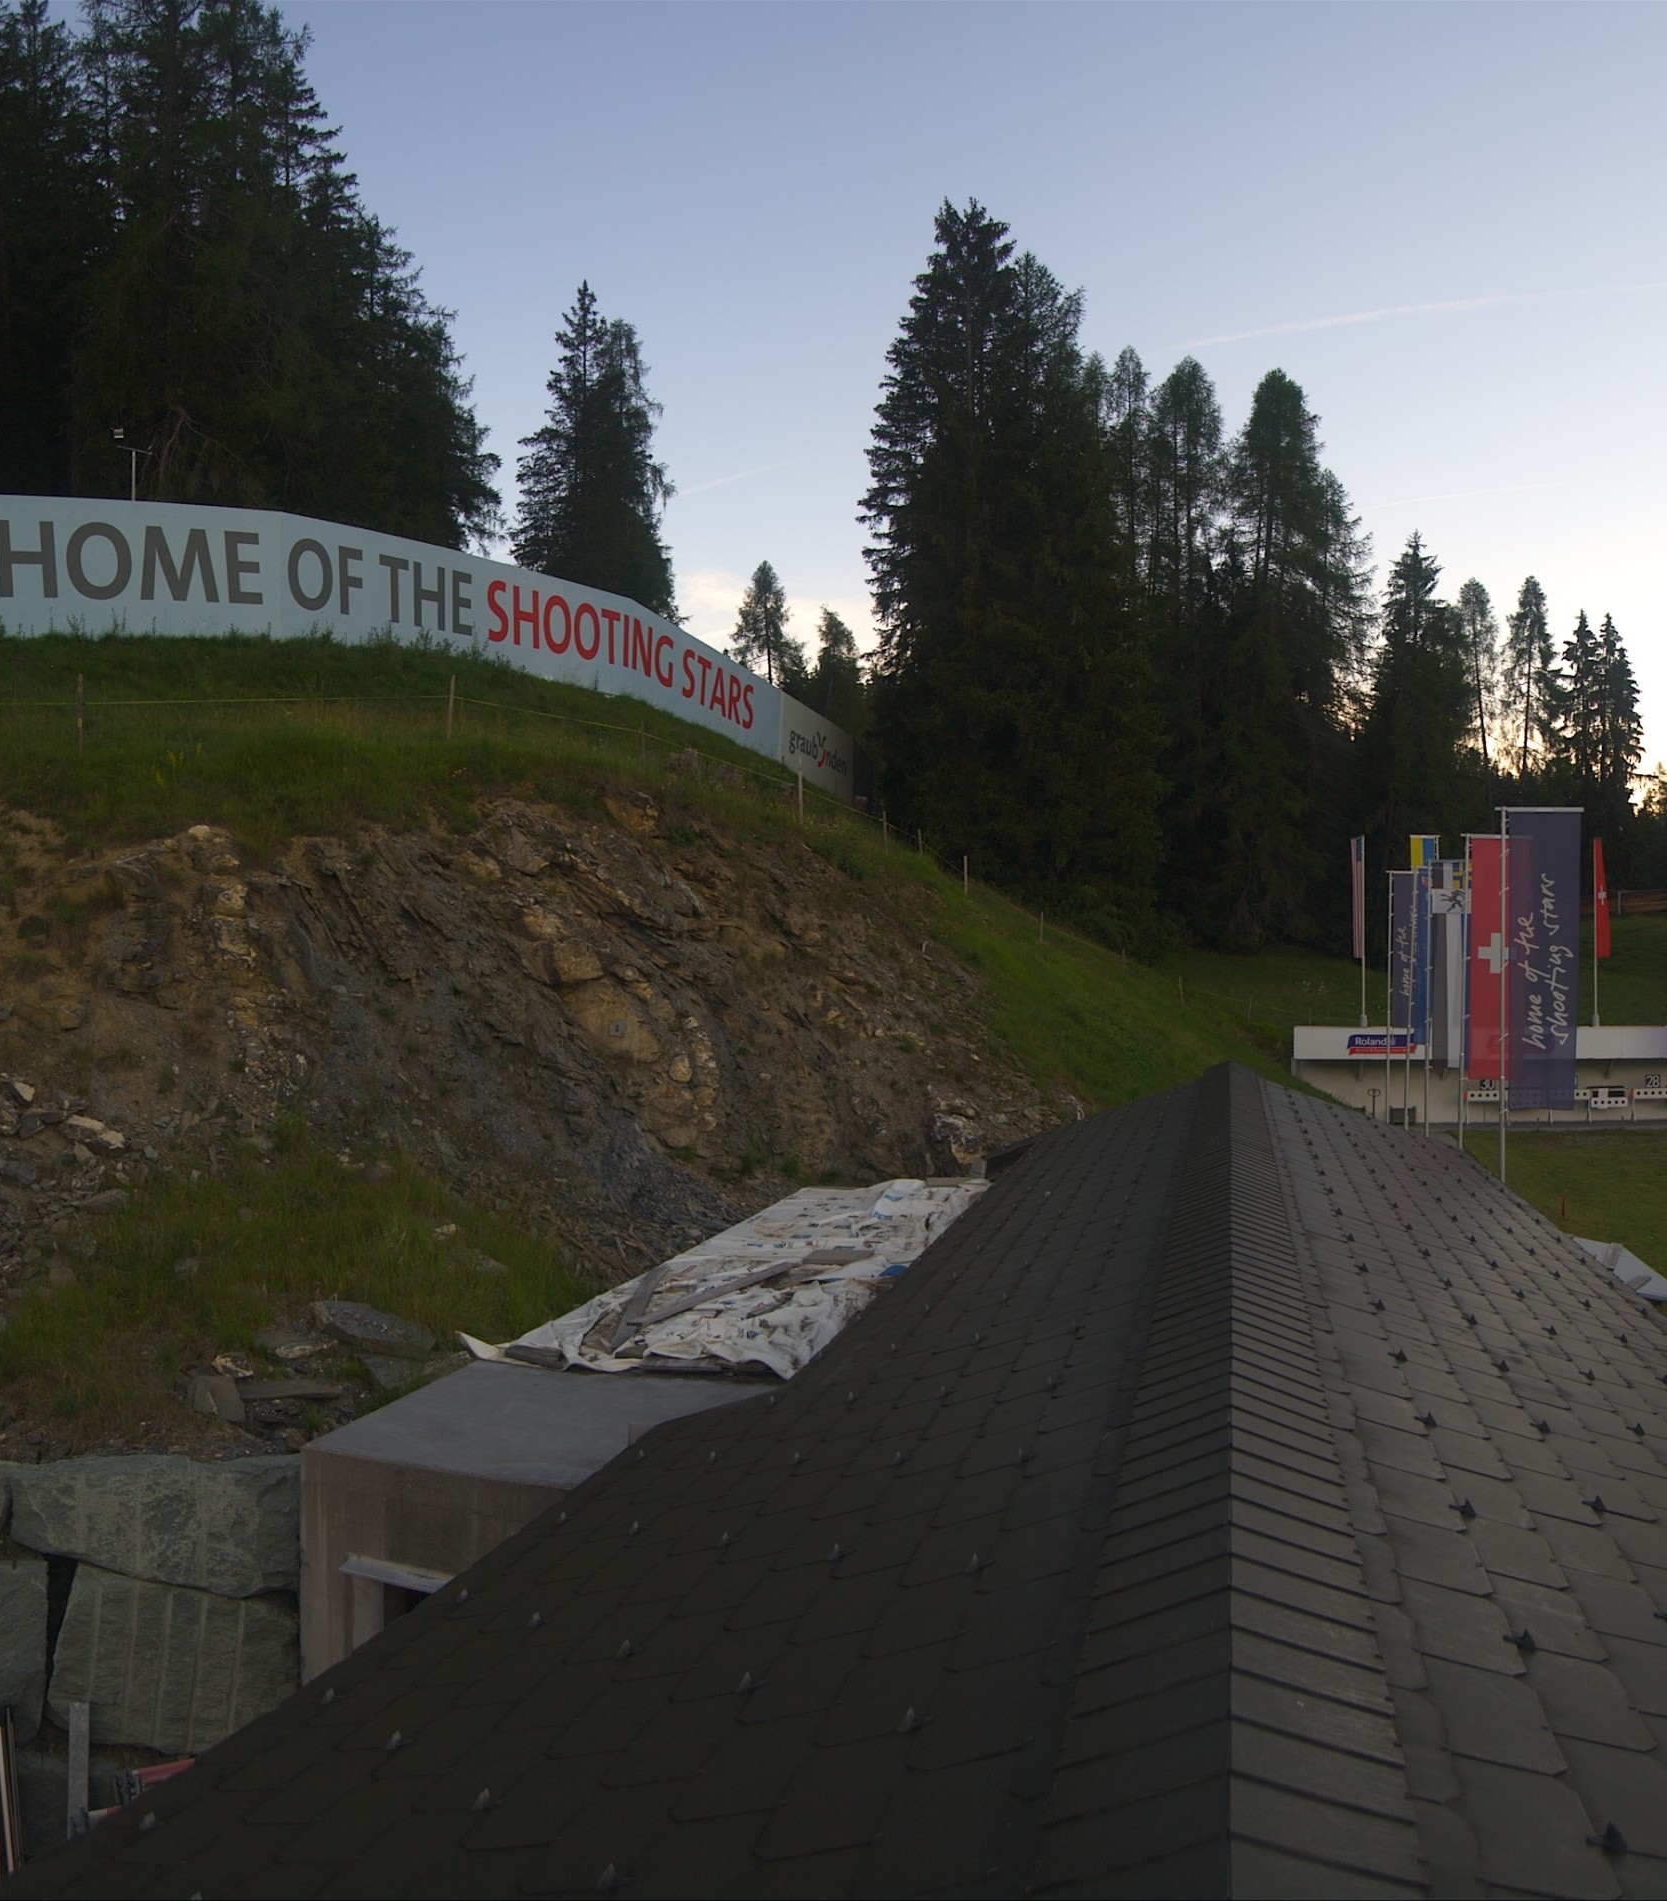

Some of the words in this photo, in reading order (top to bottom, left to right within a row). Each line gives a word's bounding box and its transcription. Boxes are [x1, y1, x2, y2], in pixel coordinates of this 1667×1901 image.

[287, 538, 364, 615] OF
[378, 552, 473, 636] THE
[486, 579, 674, 688] SHOOTING
[681, 647, 756, 730] STARS
[1513, 912, 1540, 955] the
[1517, 961, 1551, 983] of
[1545, 945, 1574, 1046] shooting
[1521, 994, 1547, 1050] home
[1354, 1036, 1387, 1046] Roland
[1480, 1078, 1495, 1091] 30
[1645, 1074, 1660, 1088] 28
